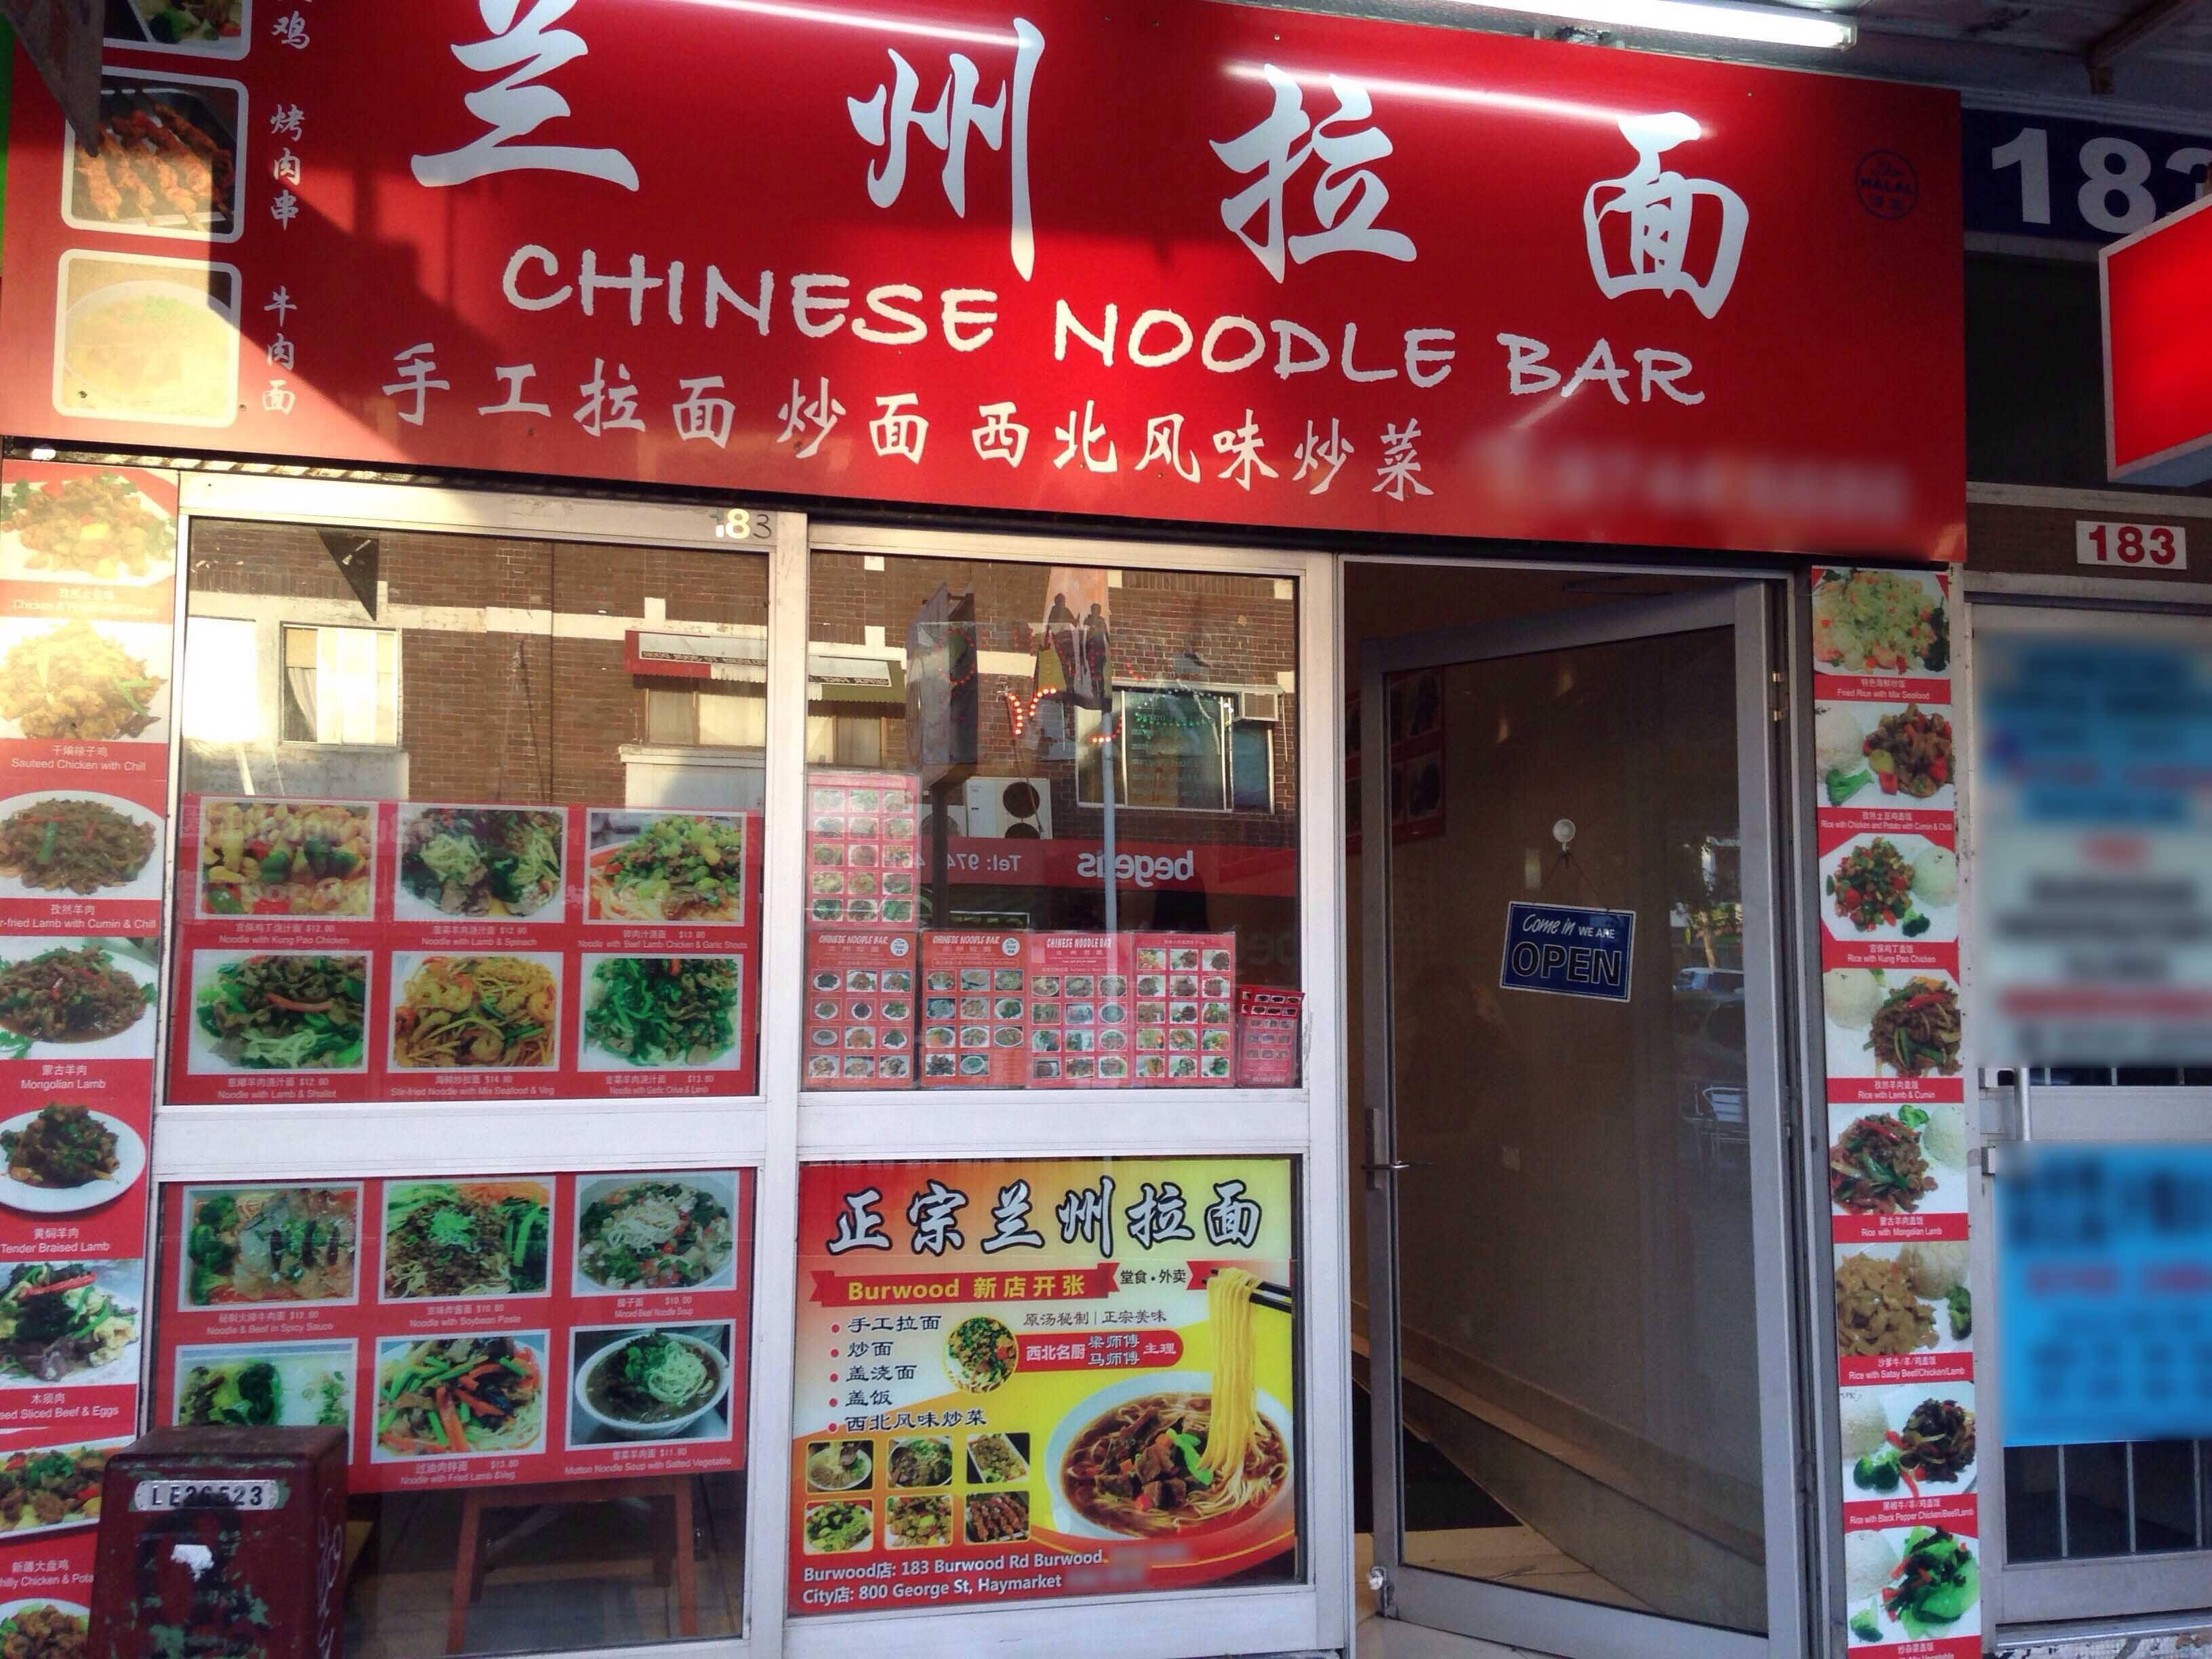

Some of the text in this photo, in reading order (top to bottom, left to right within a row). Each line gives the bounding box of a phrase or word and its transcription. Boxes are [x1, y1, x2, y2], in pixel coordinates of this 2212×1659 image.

[271, 0, 312, 49] 鸡
[270, 104, 304, 231] 烤肉串
[411, 0, 1750, 319] 兰州拉面
[503, 244, 1706, 407] CHINESE NOODLE BAR
[261, 285, 298, 415] 牛肉面
[2089, 526, 2176, 565] 183
[1902, 691, 1930, 699] Seafood
[12, 758, 54, 769] Sauteed
[56, 759, 98, 770] Chicken
[101, 760, 121, 771] with
[33, 918, 61, 928] Lamb
[64, 919, 85, 928] with
[87, 919, 121, 928] Cumin
[123, 919, 131, 928] &
[1523, 914, 1616, 939] Come in WE ARE
[218, 935, 249, 944] Noodle
[314, 936, 350, 944] Chicken
[422, 937, 451, 945] Noodle
[471, 938, 494, 946] Lamb
[1046, 937, 1073, 947] CHINESE
[1074, 937, 1098, 947] NOODLE
[1512, 941, 1622, 986] OPEN
[1847, 954, 1862, 962] Rice
[1910, 955, 1936, 963] Chicken
[21, 1079, 106, 1091] Mongolian Lamb
[218, 1090, 249, 1099] Noodle
[1858, 1090, 1873, 1099] Rice
[1889, 1090, 1907, 1099] Lamb
[826, 1175, 1262, 1258] 正宗兰州拉面
[1861, 1228, 1876, 1236] Rice
[1893, 1227, 1925, 1237] Mongolian
[1925, 1227, 1942, 1235] Lamb
[0, 1242, 110, 1254] Tender Braised Lamb
[848, 1274, 1085, 1301] Burwood 新店开张
[847, 1315, 942, 1333] 手工拉面
[847, 1341, 894, 1357] 炒面
[1026, 1343, 1177, 1361] 西北名厨 主理
[1088, 1351, 1139, 1366] 马师傅
[845, 1365, 918, 1382] 盖浇面
[1849, 1371, 1865, 1380] Rice
[1865, 1370, 1880, 1379] with
[1881, 1369, 1901, 1380] Satay
[845, 1389, 894, 1408] 盖饭
[20, 1408, 52, 1418] Sliced
[55, 1406, 80, 1418] Beef
[81, 1406, 89, 1416] &
[91, 1406, 119, 1418] Eggs
[845, 1409, 987, 1432] 西北风味炒菜
[594, 1464, 623, 1474] Noodle
[624, 1462, 646, 1471] Soup
[647, 1460, 664, 1470] with
[901, 1560, 928, 1576] 183
[935, 1555, 1004, 1574] Burwood
[1009, 1554, 1029, 1569] Rd
[20, 1573, 94, 1586] Chicken & Pota
[859, 1584, 888, 1599] 800
[892, 1582, 949, 1600] George
[977, 1574, 1062, 1595] Haymarket
